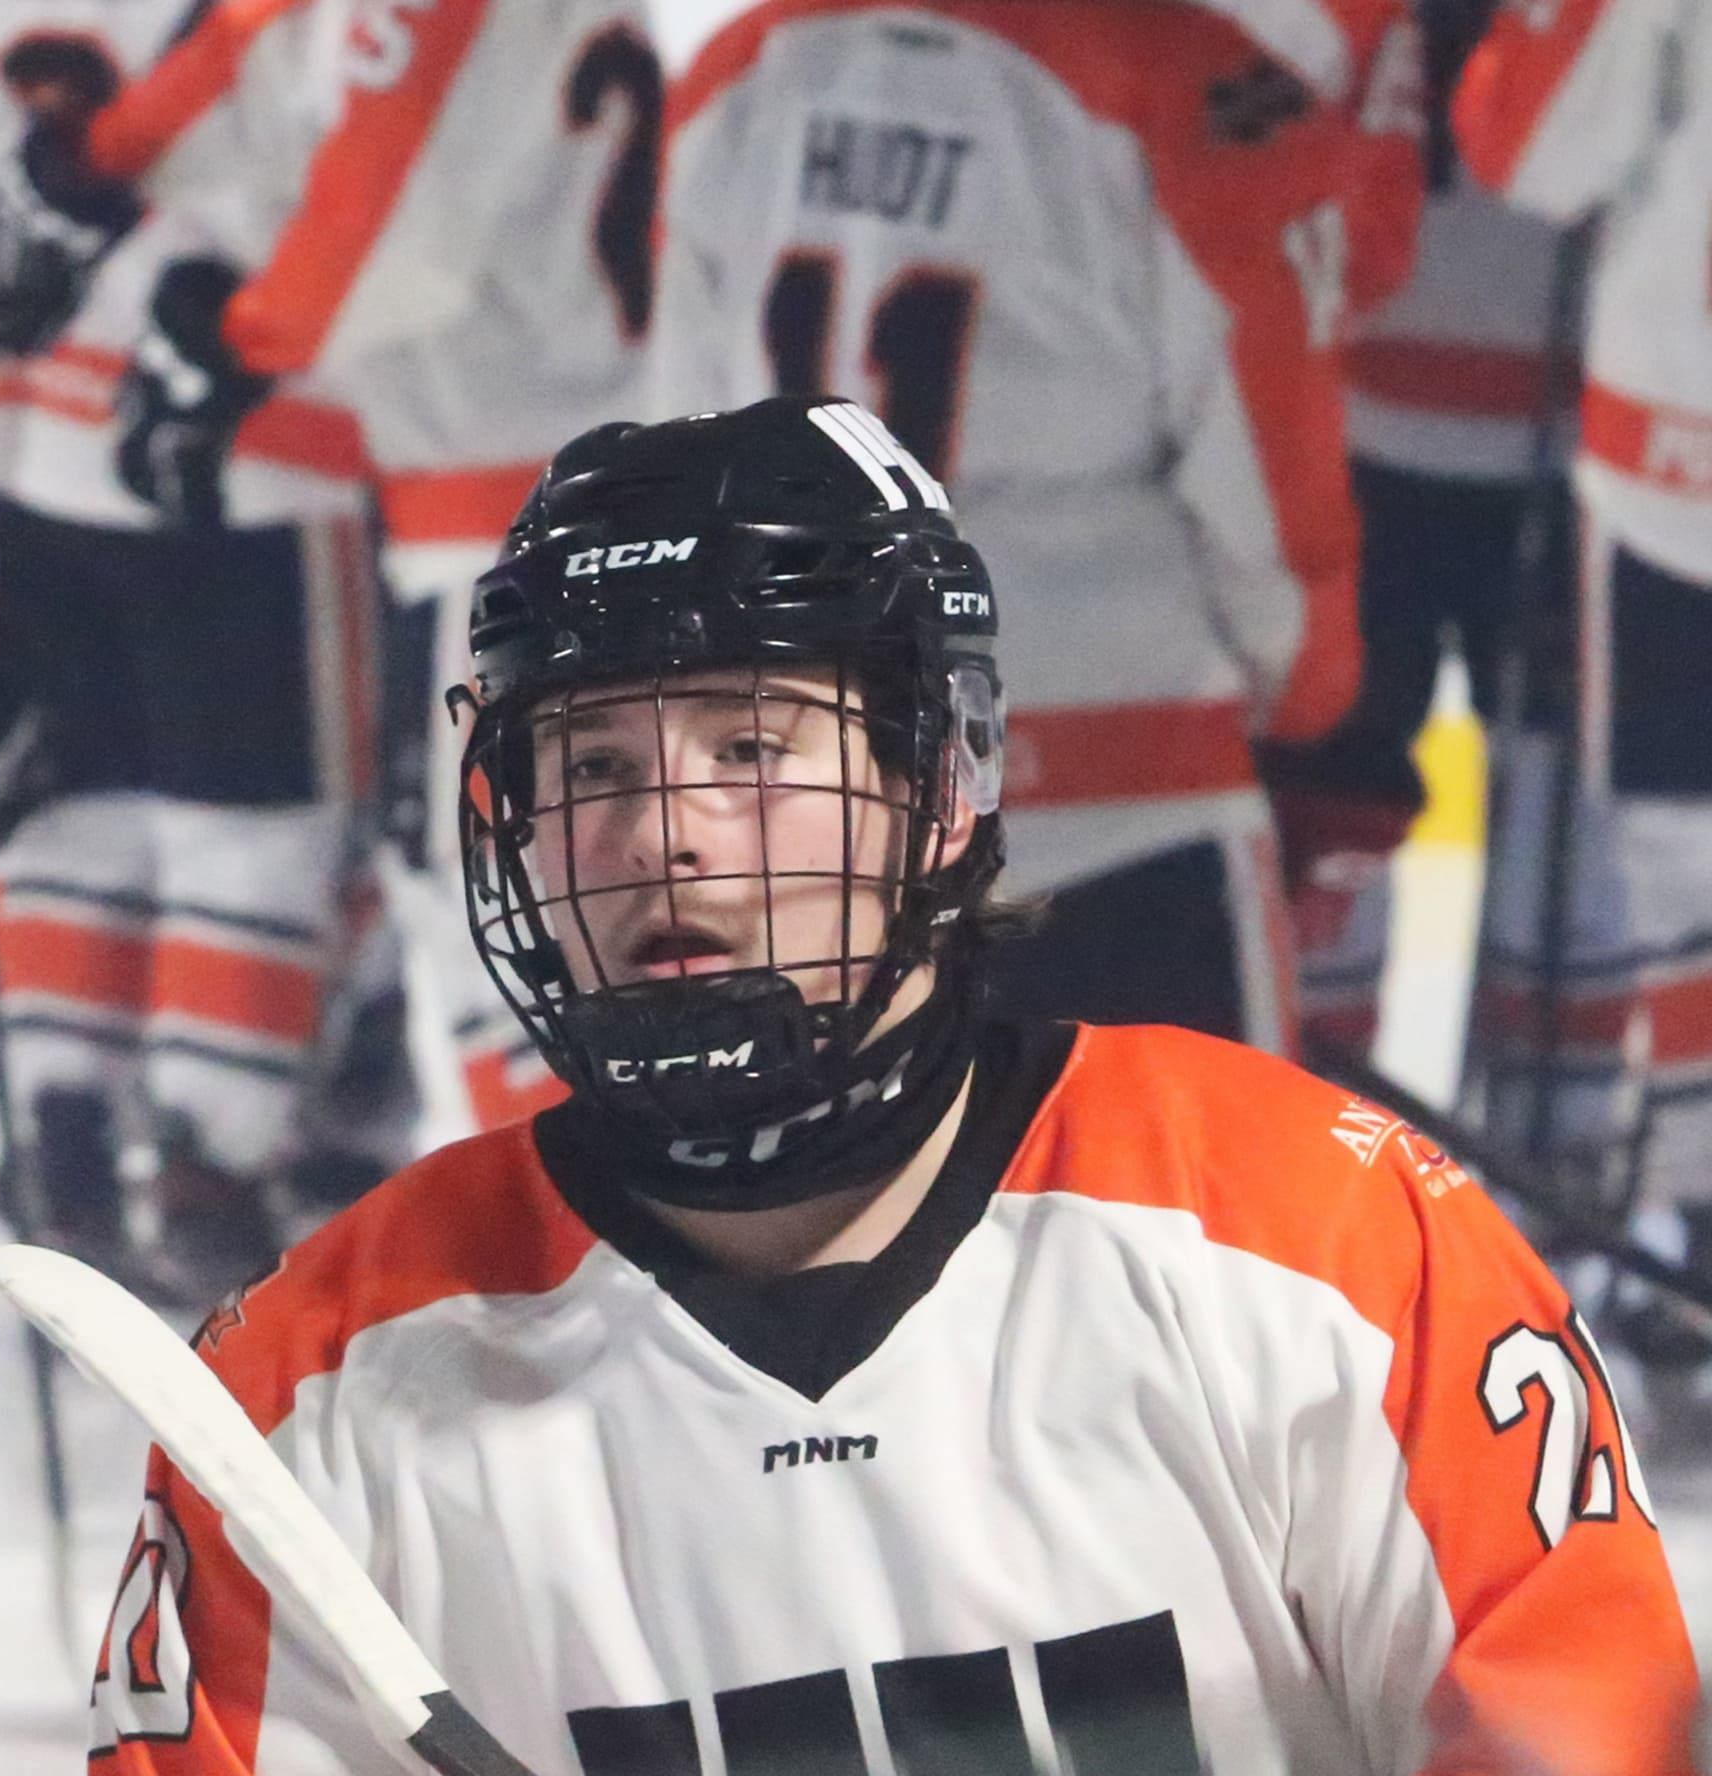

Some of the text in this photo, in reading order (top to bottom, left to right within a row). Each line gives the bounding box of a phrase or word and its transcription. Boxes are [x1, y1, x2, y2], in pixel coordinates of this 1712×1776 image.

[564, 537, 698, 578] CCM
[942, 591, 990, 616] CCM
[763, 1434, 879, 1474] MNM
